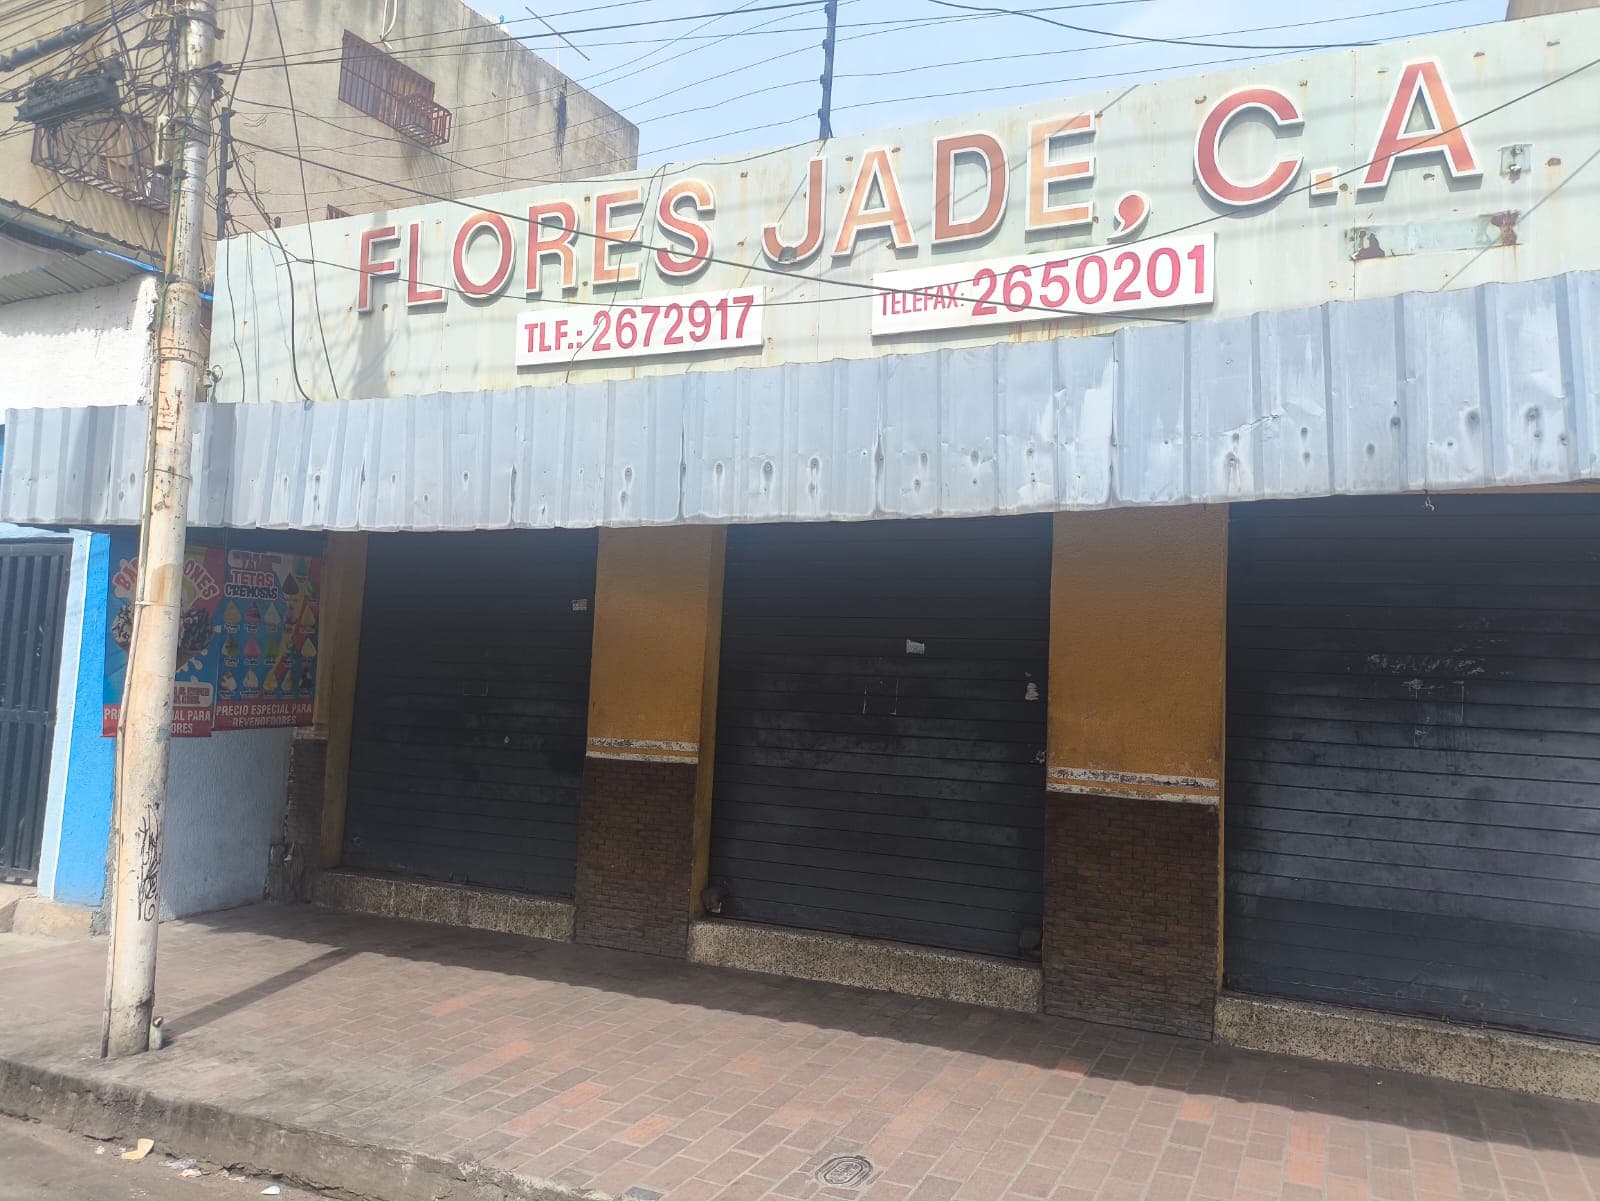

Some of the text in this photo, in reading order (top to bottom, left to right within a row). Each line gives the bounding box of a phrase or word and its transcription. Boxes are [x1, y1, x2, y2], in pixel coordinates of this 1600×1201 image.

[358, 178, 717, 312] FLORES
[761, 110, 1150, 263] JADE,
[880, 244, 1206, 317] TELEFAX: 2650201
[591, 295, 755, 353] 2672917
[231, 570, 276, 588] TETAS
[187, 710, 211, 721] PARA
[216, 703, 312, 717] PRECIO ESPECIAL PARA
